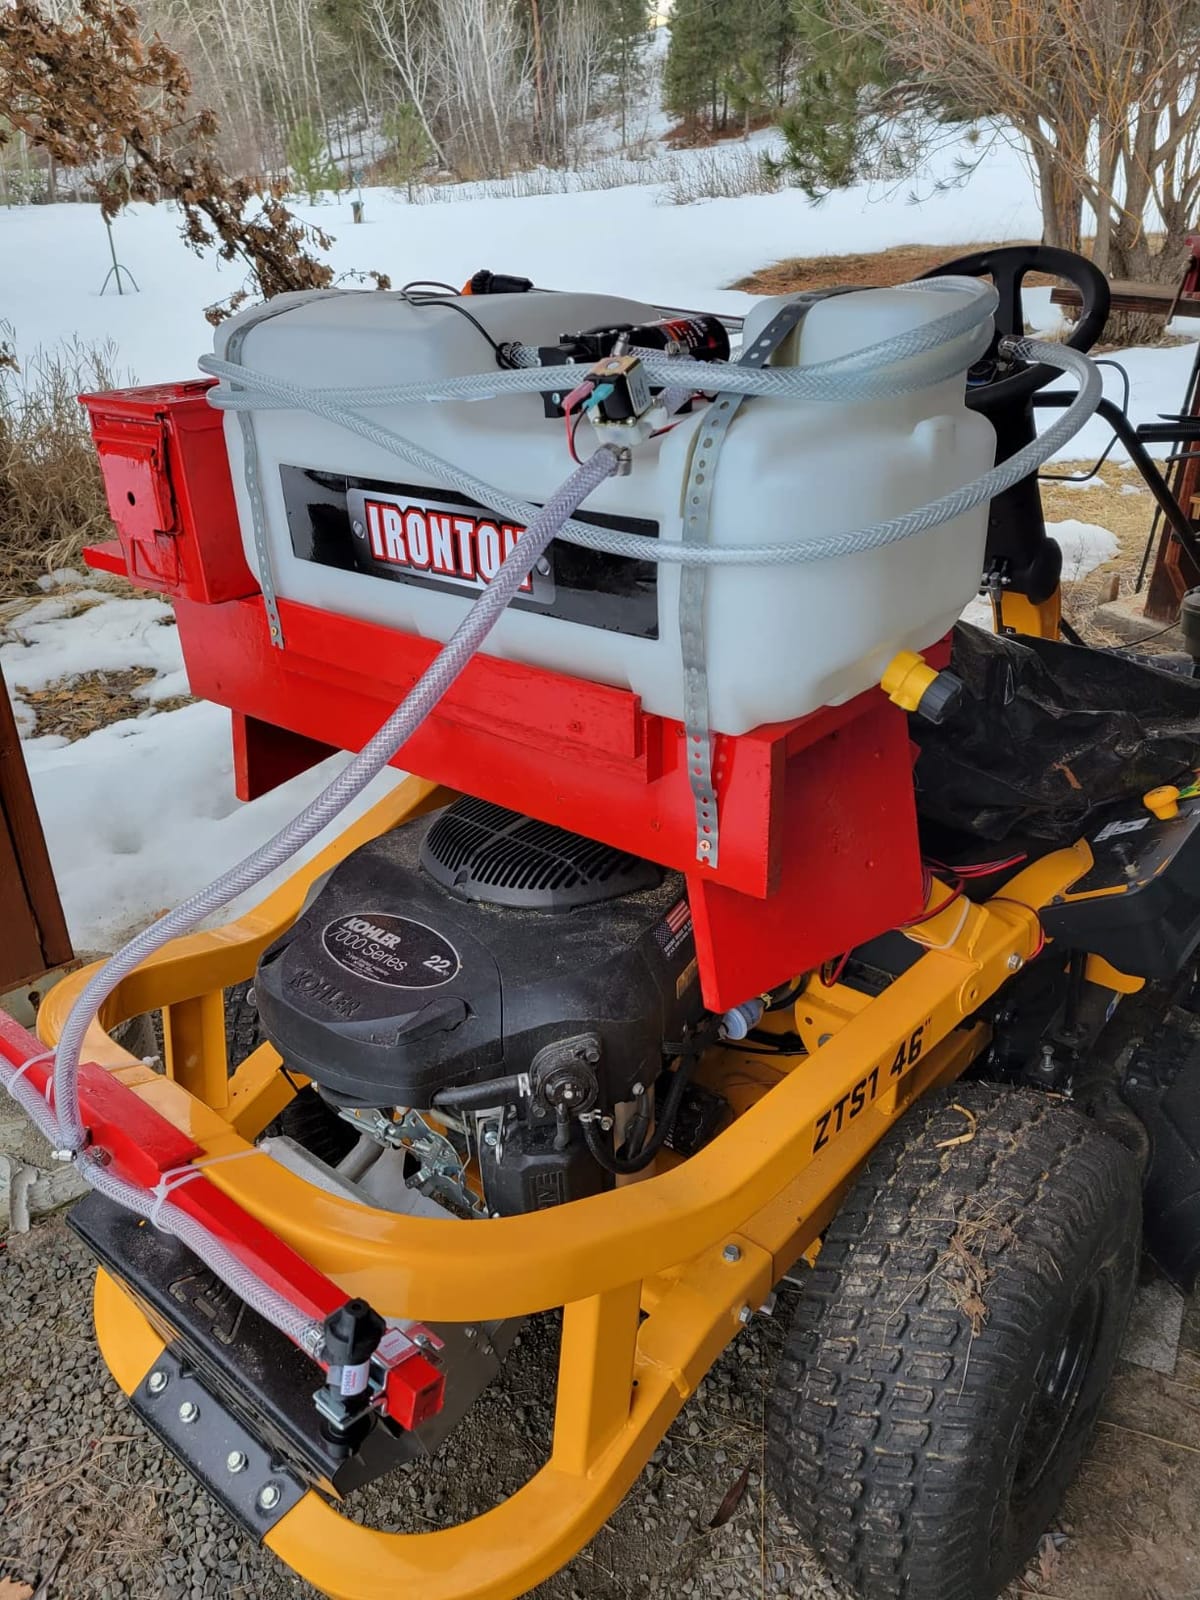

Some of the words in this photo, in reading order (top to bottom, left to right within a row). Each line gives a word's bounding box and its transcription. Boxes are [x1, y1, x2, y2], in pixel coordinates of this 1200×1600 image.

[328, 927, 367, 950] 7000
[362, 943, 408, 972] Series
[343, 917, 401, 950] KOHLER
[422, 955, 451, 973] 22
[812, 1065, 880, 1155] ZTS1
[889, 1016, 932, 1077] 46"
